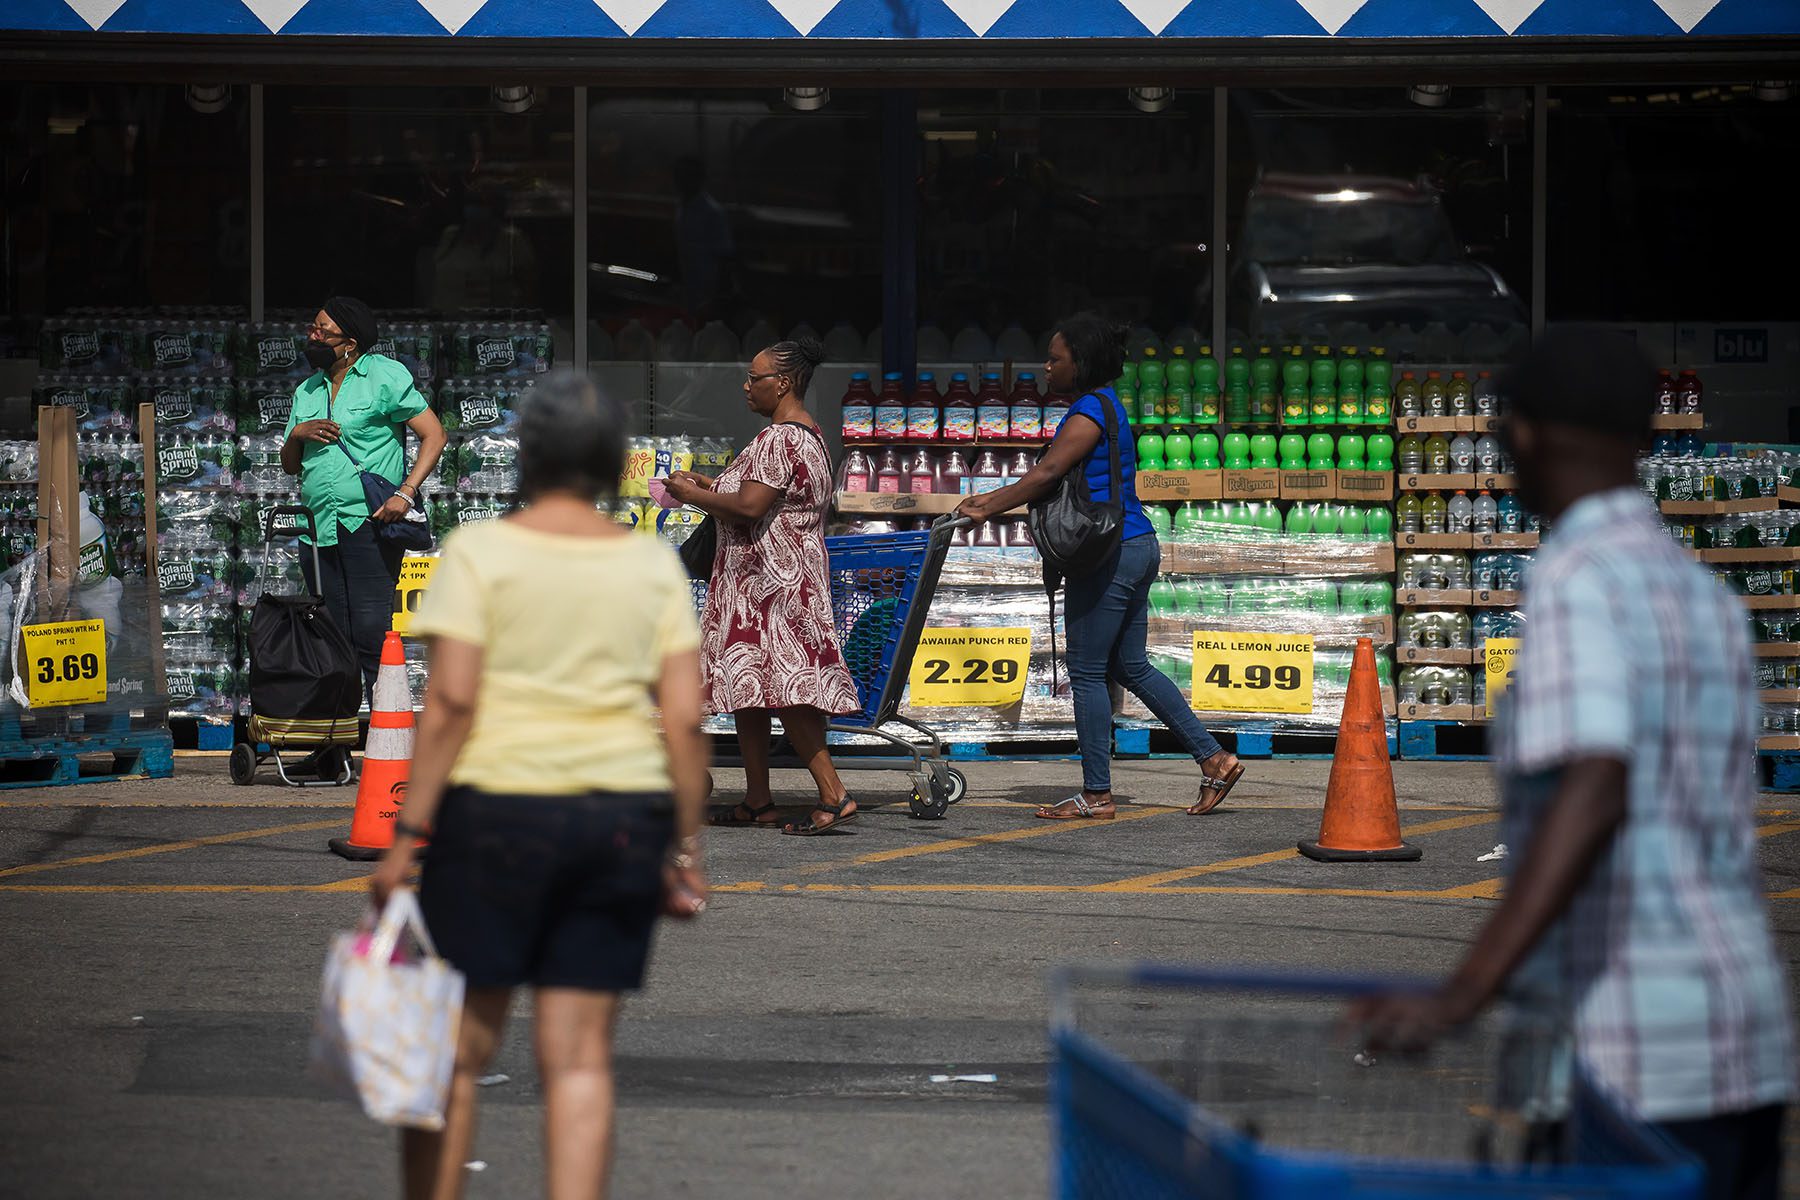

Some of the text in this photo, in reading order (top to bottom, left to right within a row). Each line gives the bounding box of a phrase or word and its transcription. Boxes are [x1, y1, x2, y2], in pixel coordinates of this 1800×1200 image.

[62, 331, 98, 350] Poland
[154, 334, 190, 351] Poland
[257, 337, 295, 353] Poland
[476, 339, 514, 354] Poland
[1718, 334, 1764, 358] blu
[63, 343, 99, 359] Spring
[156, 344, 192, 361] Spring
[259, 348, 297, 367] Spring
[478, 350, 515, 366] Spring
[154, 391, 191, 406] Poland
[459, 396, 498, 411] Poland
[157, 402, 192, 417] Spring
[260, 407, 291, 424] Sprin
[461, 406, 499, 423] Spring
[1407, 418, 1417, 429] G
[158, 444, 197, 463] Poland
[657, 453, 670, 462] 40
[160, 458, 198, 477] Spring
[1408, 477, 1417, 487] G
[1485, 478, 1495, 488] G
[458, 504, 494, 523] Poland
[1406, 534, 1415, 544] G
[1482, 534, 1492, 545] G
[157, 560, 193, 578] Poland
[159, 570, 194, 588] Spring
[1480, 591, 1489, 601] G
[27, 624, 100, 637] POLAND SPRING WTR HLF
[969, 637, 1004, 645] PUNCH
[1197, 641, 1310, 652] REAL LEMON JUICE
[1407, 649, 1416, 659] G
[37, 653, 98, 683] 3.69
[924, 659, 1018, 684] 2.29
[1205, 664, 1301, 690] 4.99
[121, 677, 144, 695] Spring
[1408, 706, 1416, 716] G
